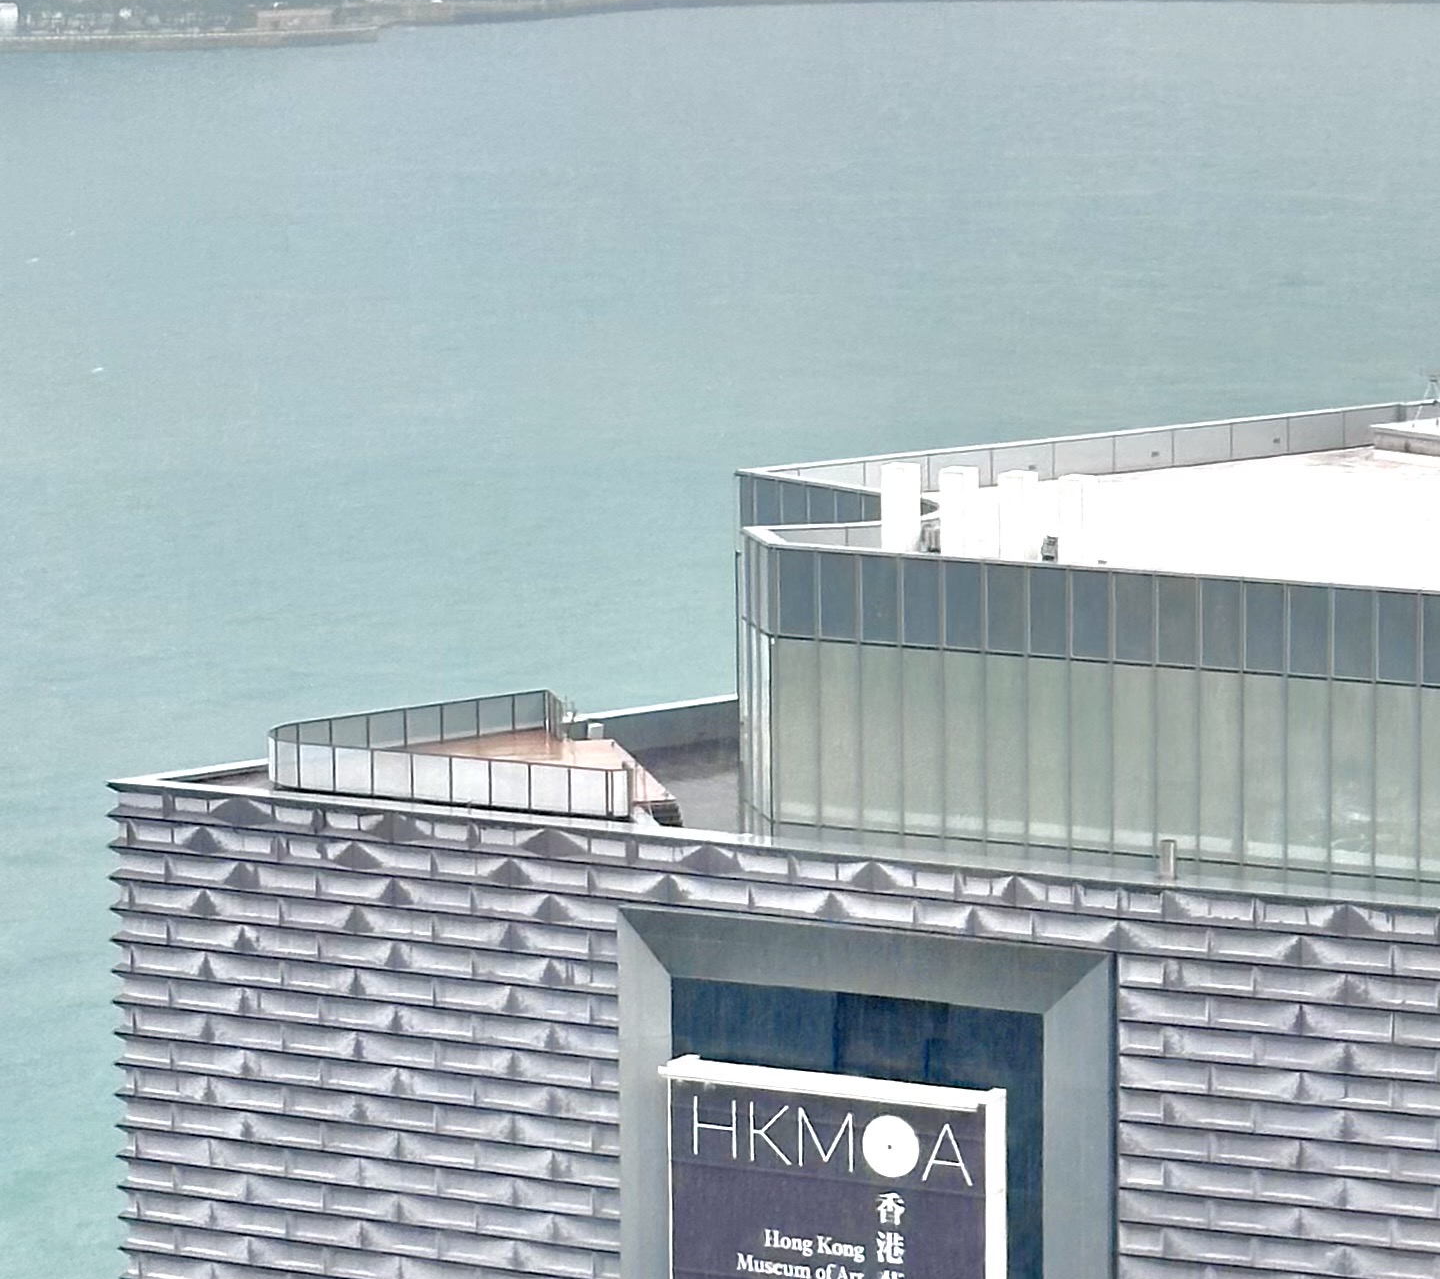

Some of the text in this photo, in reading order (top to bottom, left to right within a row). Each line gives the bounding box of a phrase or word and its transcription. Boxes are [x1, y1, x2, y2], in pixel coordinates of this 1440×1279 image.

[692, 1094, 973, 1187] HKMOA
[763, 1228, 866, 1263] Hong Kong
[736, 1253, 812, 1279] Museum
